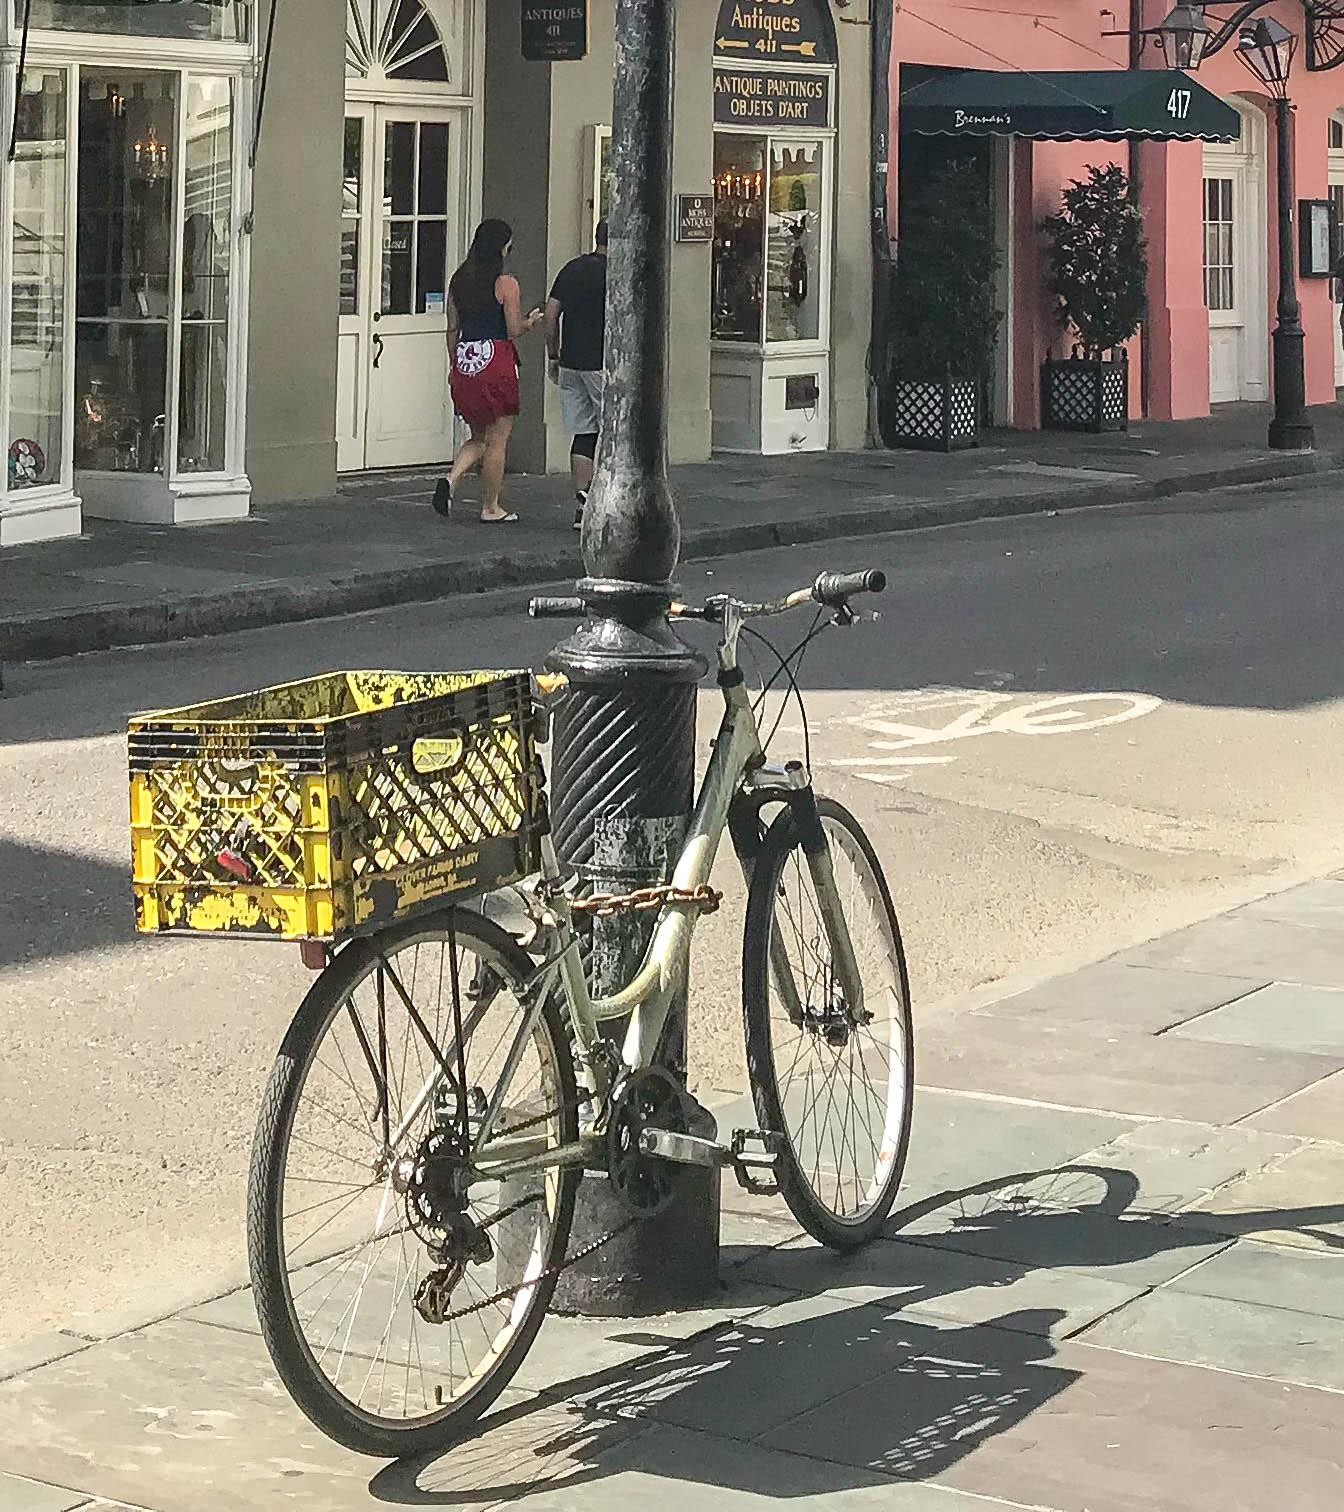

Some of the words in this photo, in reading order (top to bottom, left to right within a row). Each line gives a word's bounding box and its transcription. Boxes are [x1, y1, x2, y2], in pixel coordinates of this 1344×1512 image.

[525, 8, 584, 21] ANTIQUES
[731, 4, 801, 40] Antiques
[755, 39, 777, 53] 411
[714, 75, 763, 98] ANTIQUE
[767, 78, 823, 99] PAINTINGS
[730, 98, 774, 117] OBJETS
[779, 101, 809, 119] D'ART
[1167, 88, 1191, 119] 417
[954, 109, 1011, 128] Brennan's
